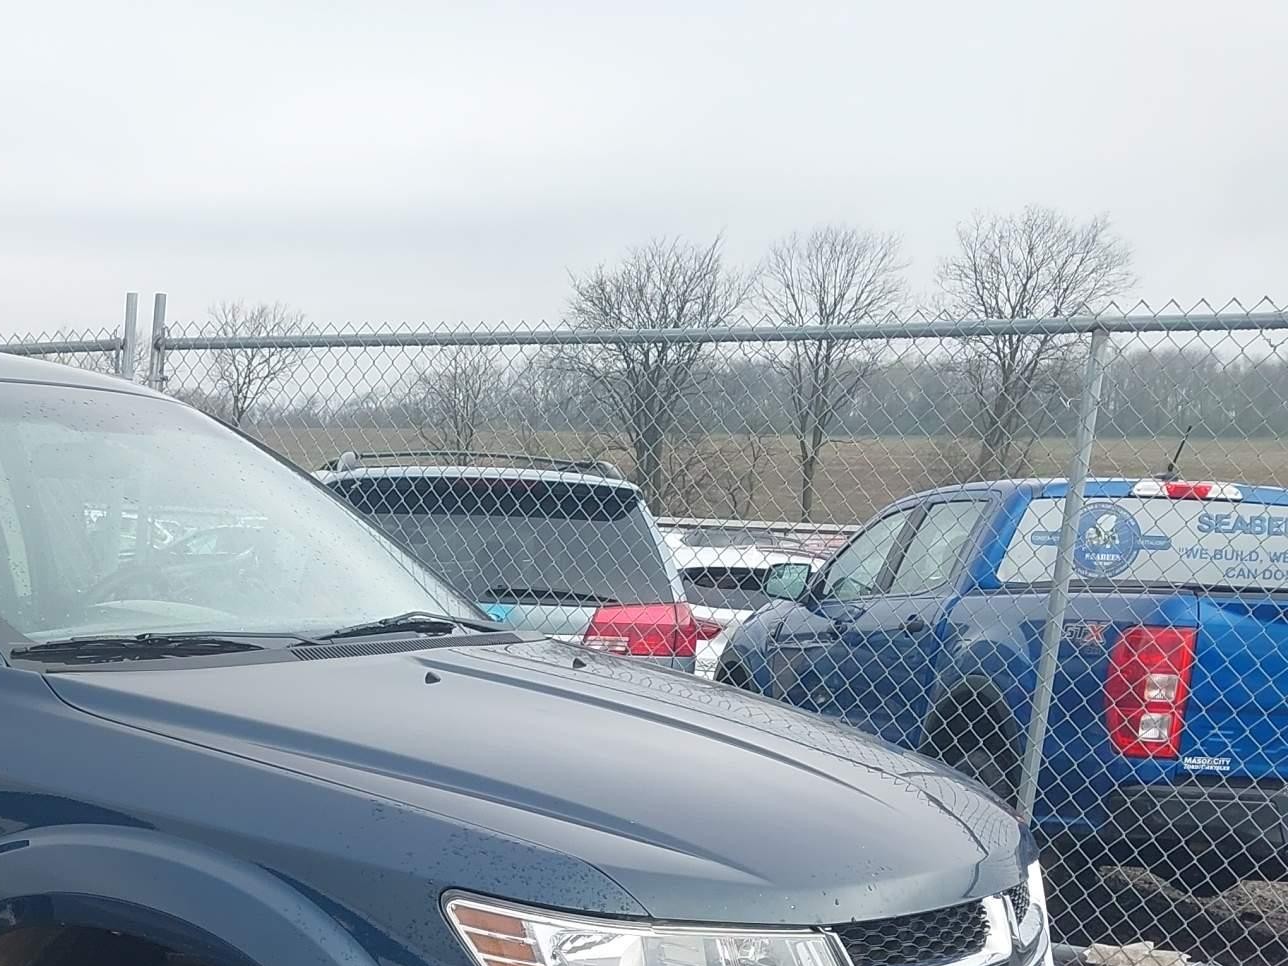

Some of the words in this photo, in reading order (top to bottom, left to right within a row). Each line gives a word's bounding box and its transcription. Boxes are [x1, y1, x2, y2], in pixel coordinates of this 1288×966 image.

[1197, 512, 1288, 536] SEABE
[1224, 566, 1258, 579] CAN
[1213, 757, 1231, 765] CITY
